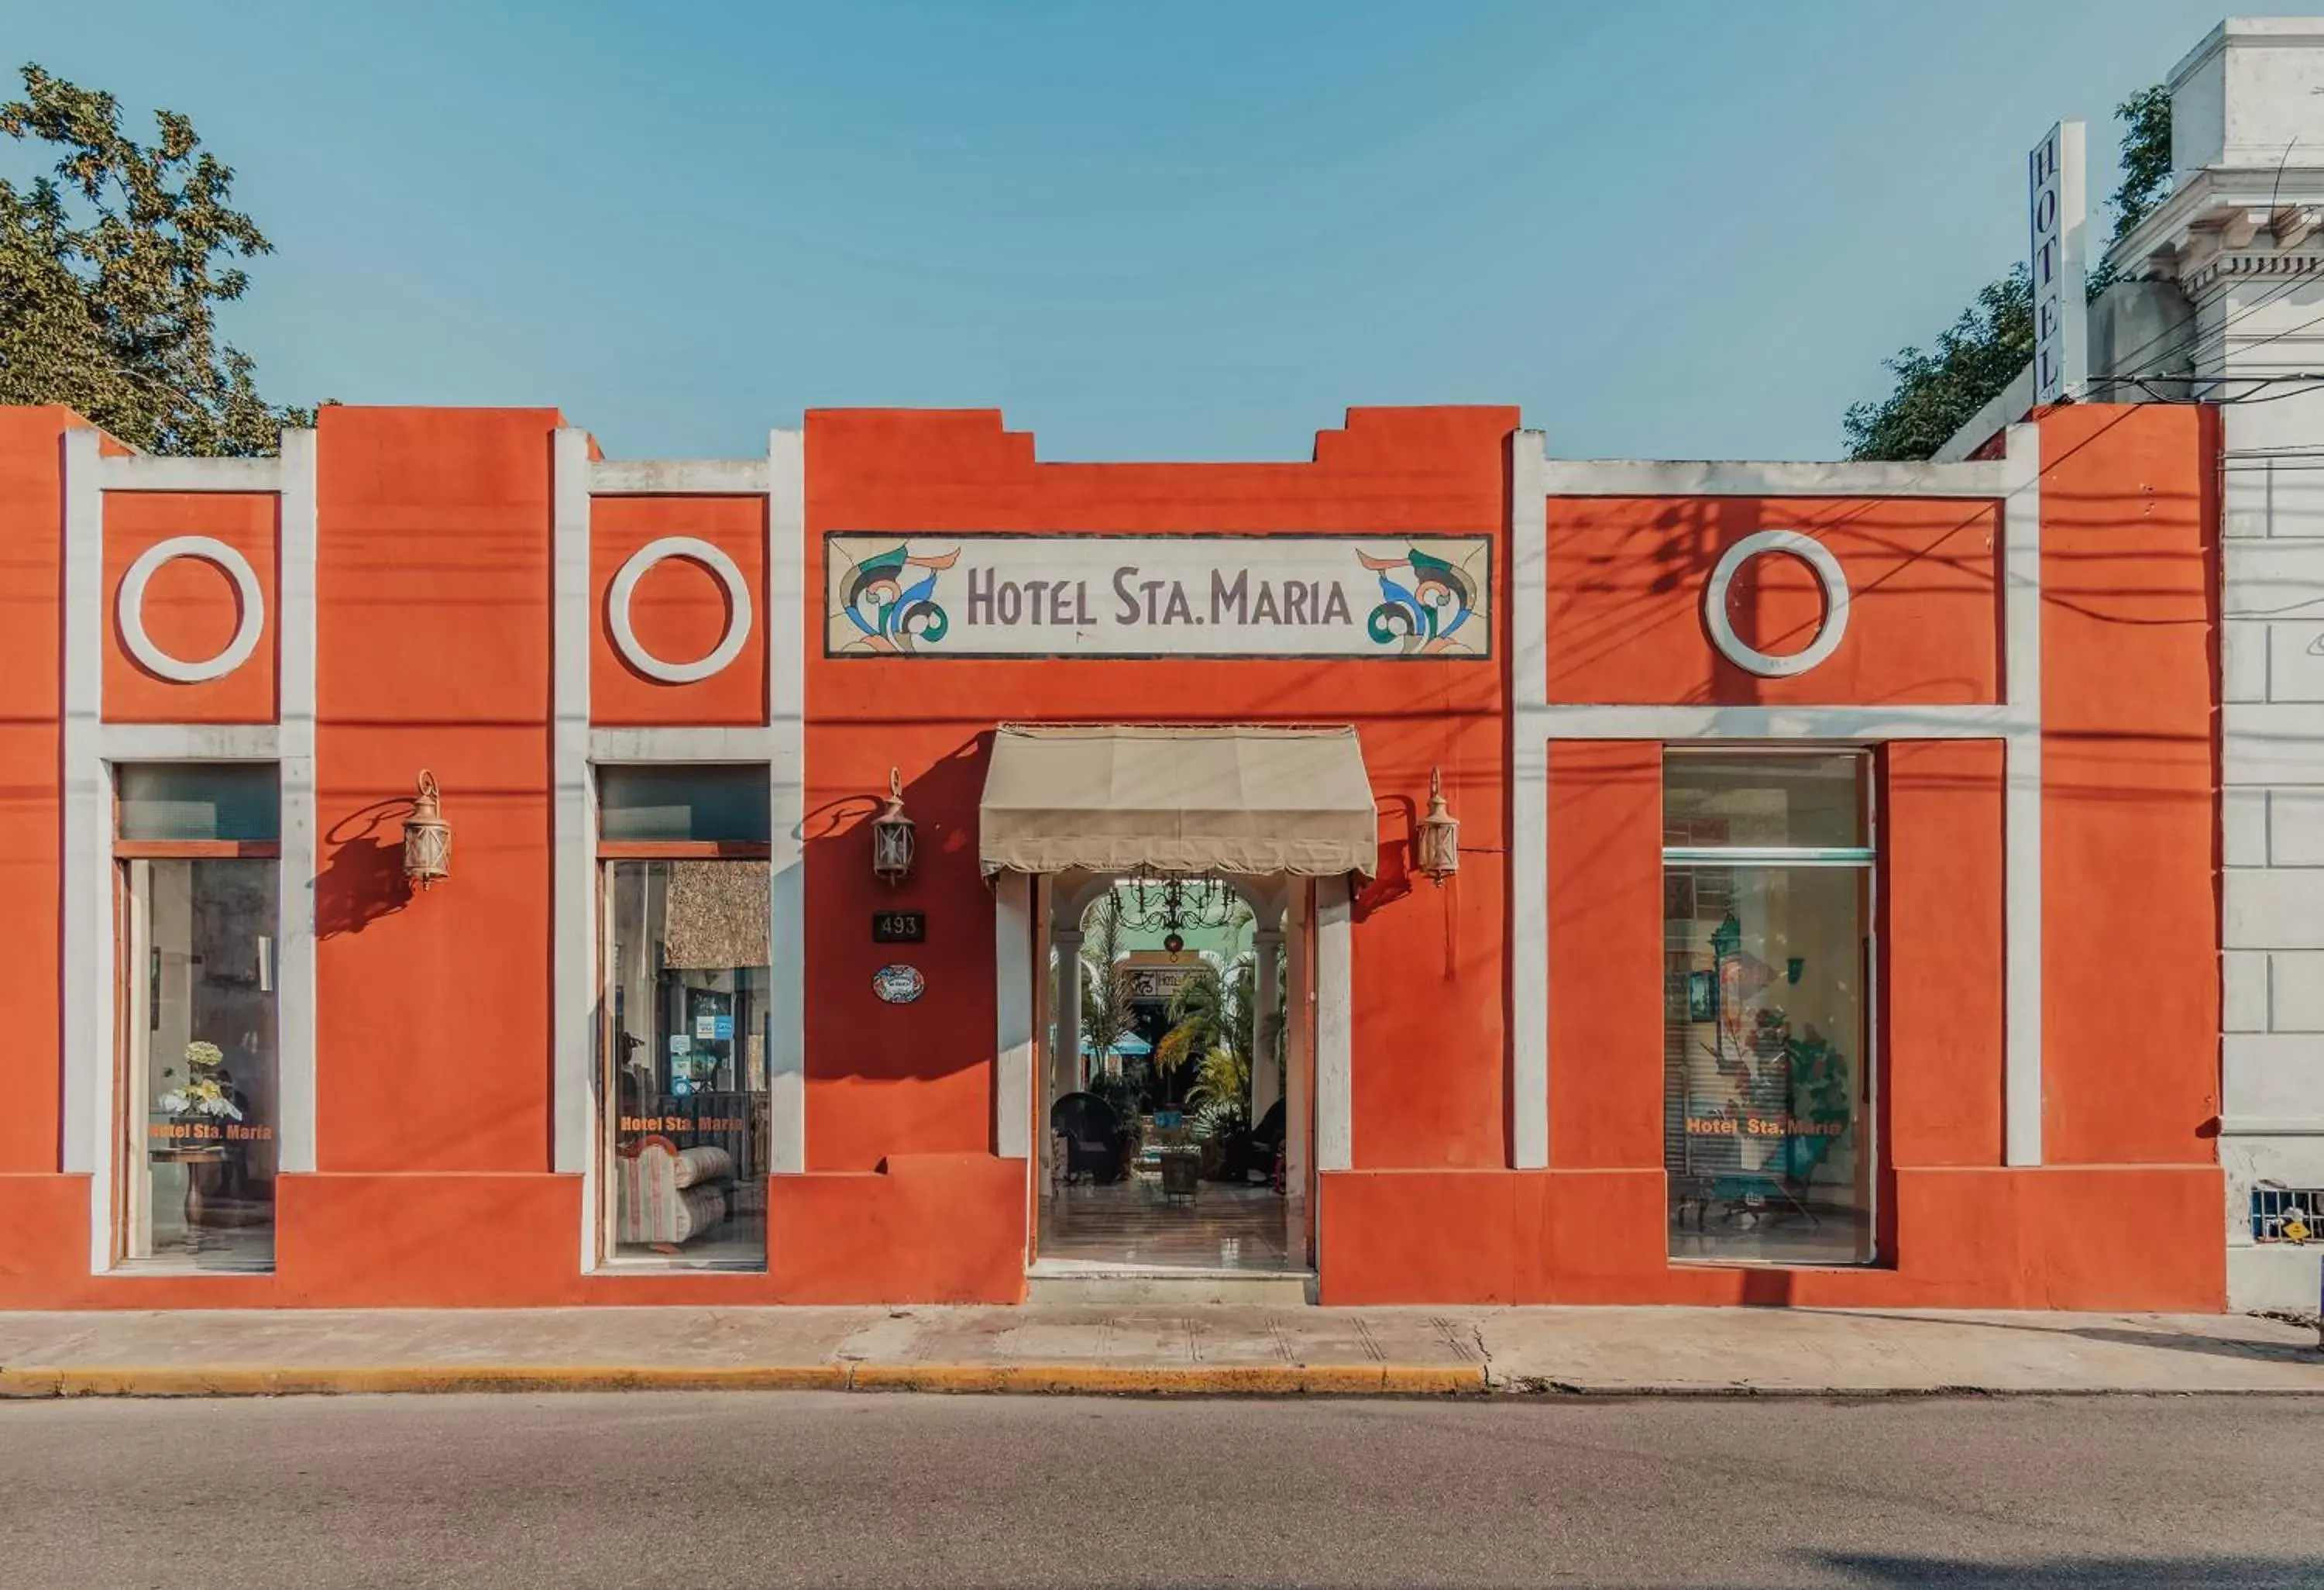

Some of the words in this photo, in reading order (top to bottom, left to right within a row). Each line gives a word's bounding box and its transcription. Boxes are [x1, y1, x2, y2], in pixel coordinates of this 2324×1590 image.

[2037, 138, 2058, 393] HOTEL
[968, 566, 1097, 625] HOTEL
[1113, 566, 1203, 626] STA.
[1212, 567, 1353, 625] MARIA
[882, 917, 916, 934] 493
[194, 1123, 223, 1139] Sta.
[228, 1124, 272, 1140] Maria
[621, 1116, 662, 1131] Hotel
[665, 1116, 695, 1131] Sta.
[1686, 1118, 1737, 1134] Hotel
[1747, 1118, 1784, 1135] Sta.
[1787, 1120, 1842, 1136] Maria
